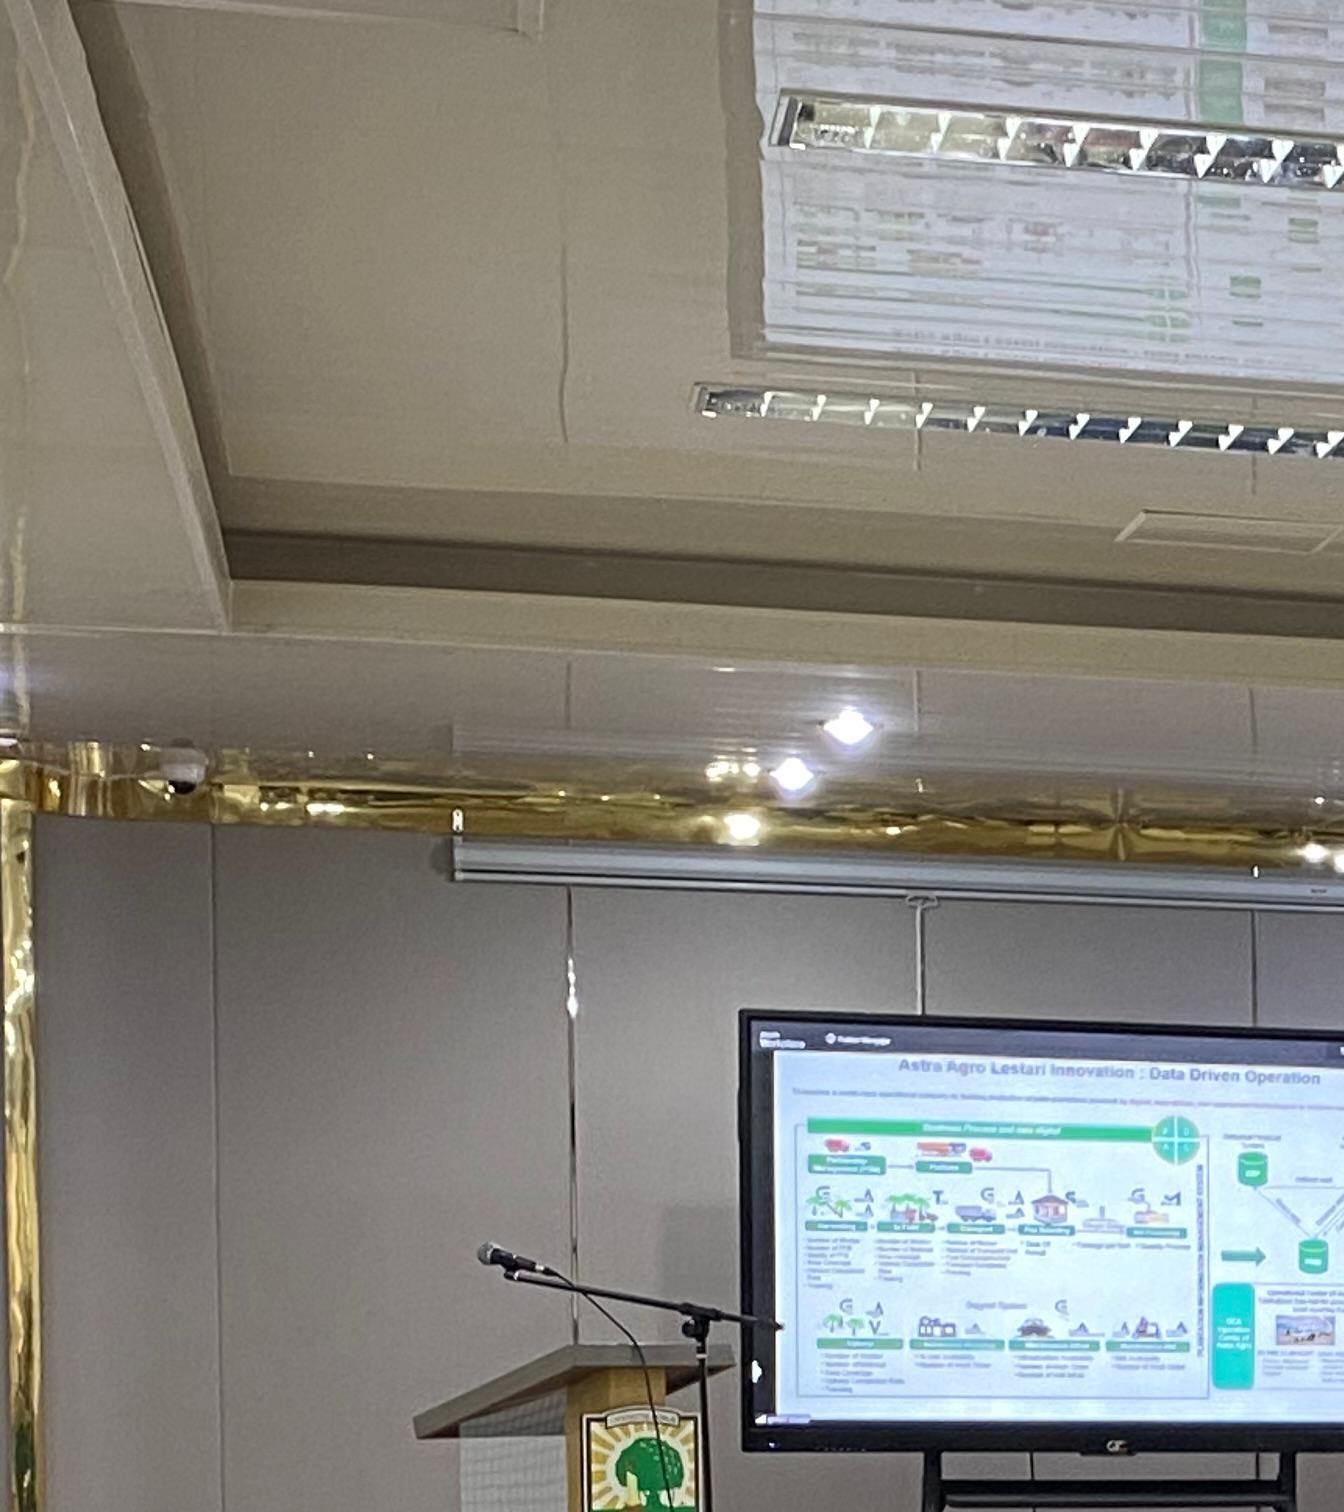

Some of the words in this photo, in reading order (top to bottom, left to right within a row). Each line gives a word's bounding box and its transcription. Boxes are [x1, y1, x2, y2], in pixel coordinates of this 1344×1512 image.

[899, 1058, 943, 1073] Astra
[947, 1060, 986, 1077] Agro
[991, 1061, 1046, 1076] Lestari
[1050, 1063, 1135, 1079] Innovation
[1149, 1066, 1185, 1081] Data
[1190, 1068, 1240, 1083] Driven
[1245, 1070, 1321, 1086] Operation
